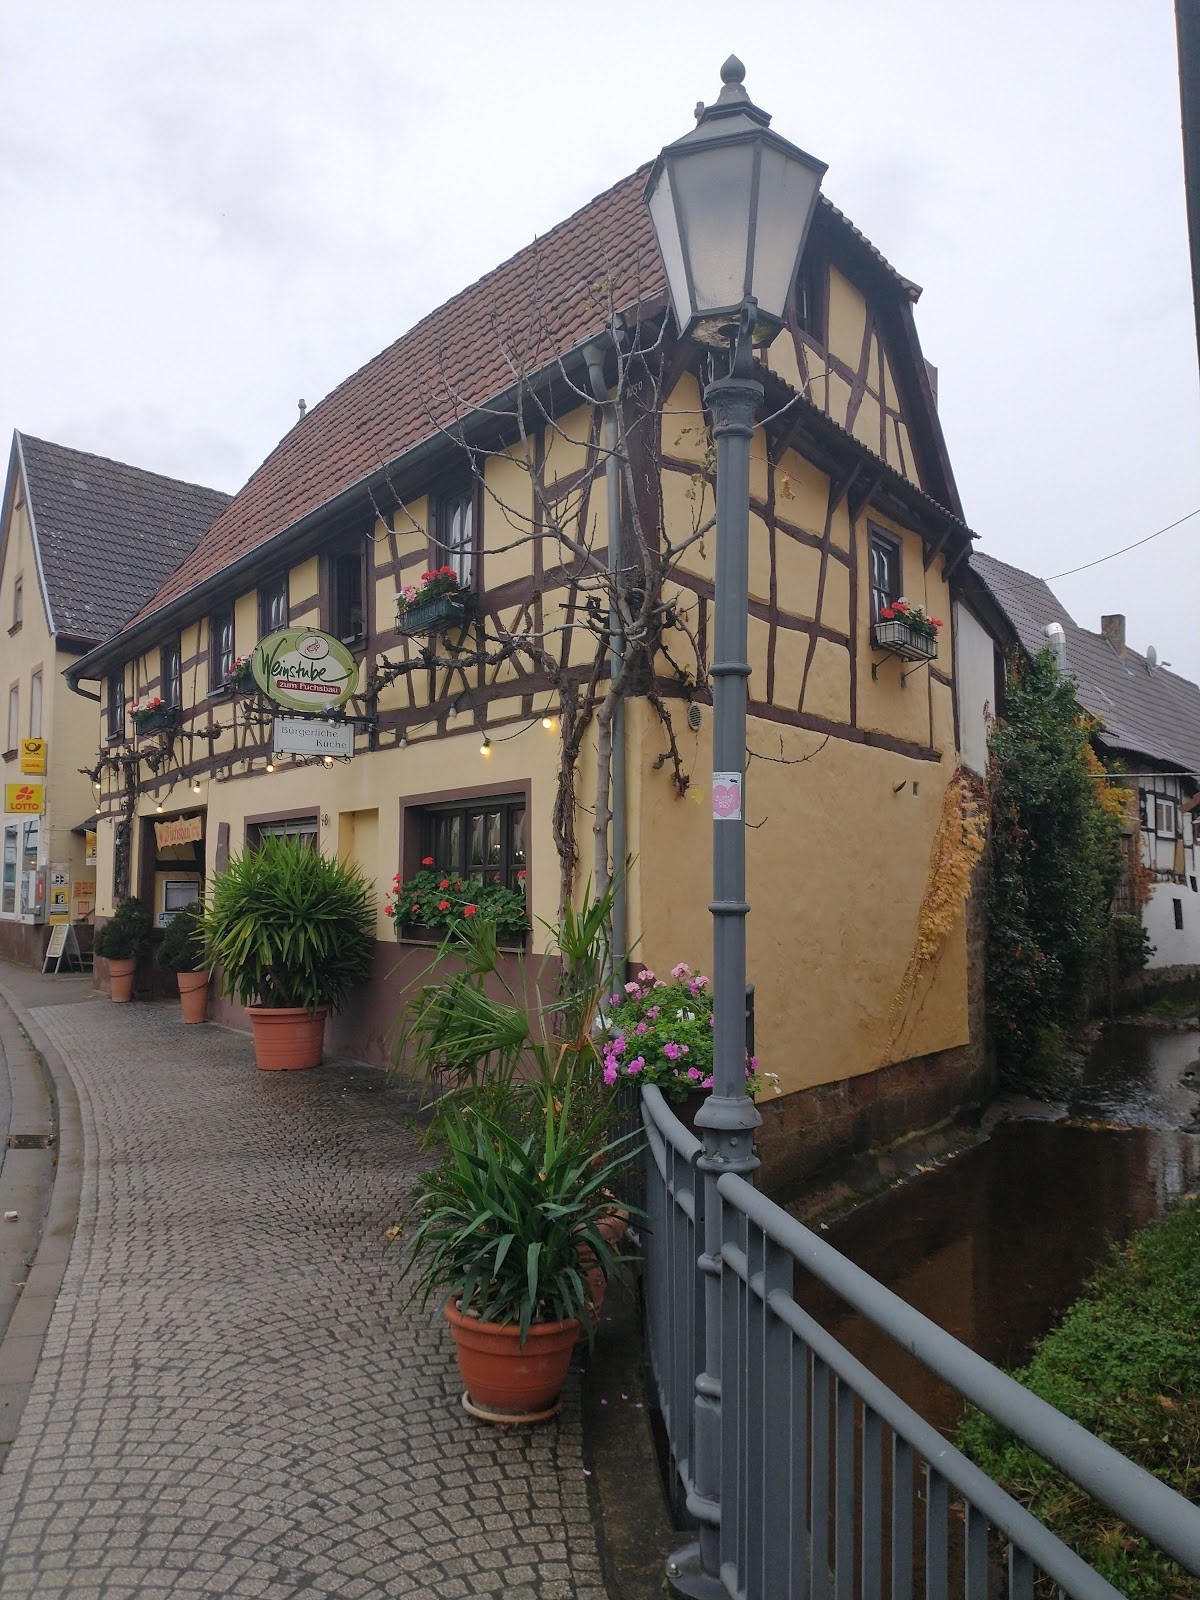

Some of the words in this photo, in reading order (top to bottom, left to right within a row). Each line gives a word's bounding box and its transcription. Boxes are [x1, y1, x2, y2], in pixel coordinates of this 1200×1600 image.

[261, 637, 353, 694] Weinstube
[279, 682, 299, 690] zum
[299, 683, 338, 694] Fuchsbau
[281, 726, 338, 738] Bürgerliche
[10, 802, 39, 811] LOTTO
